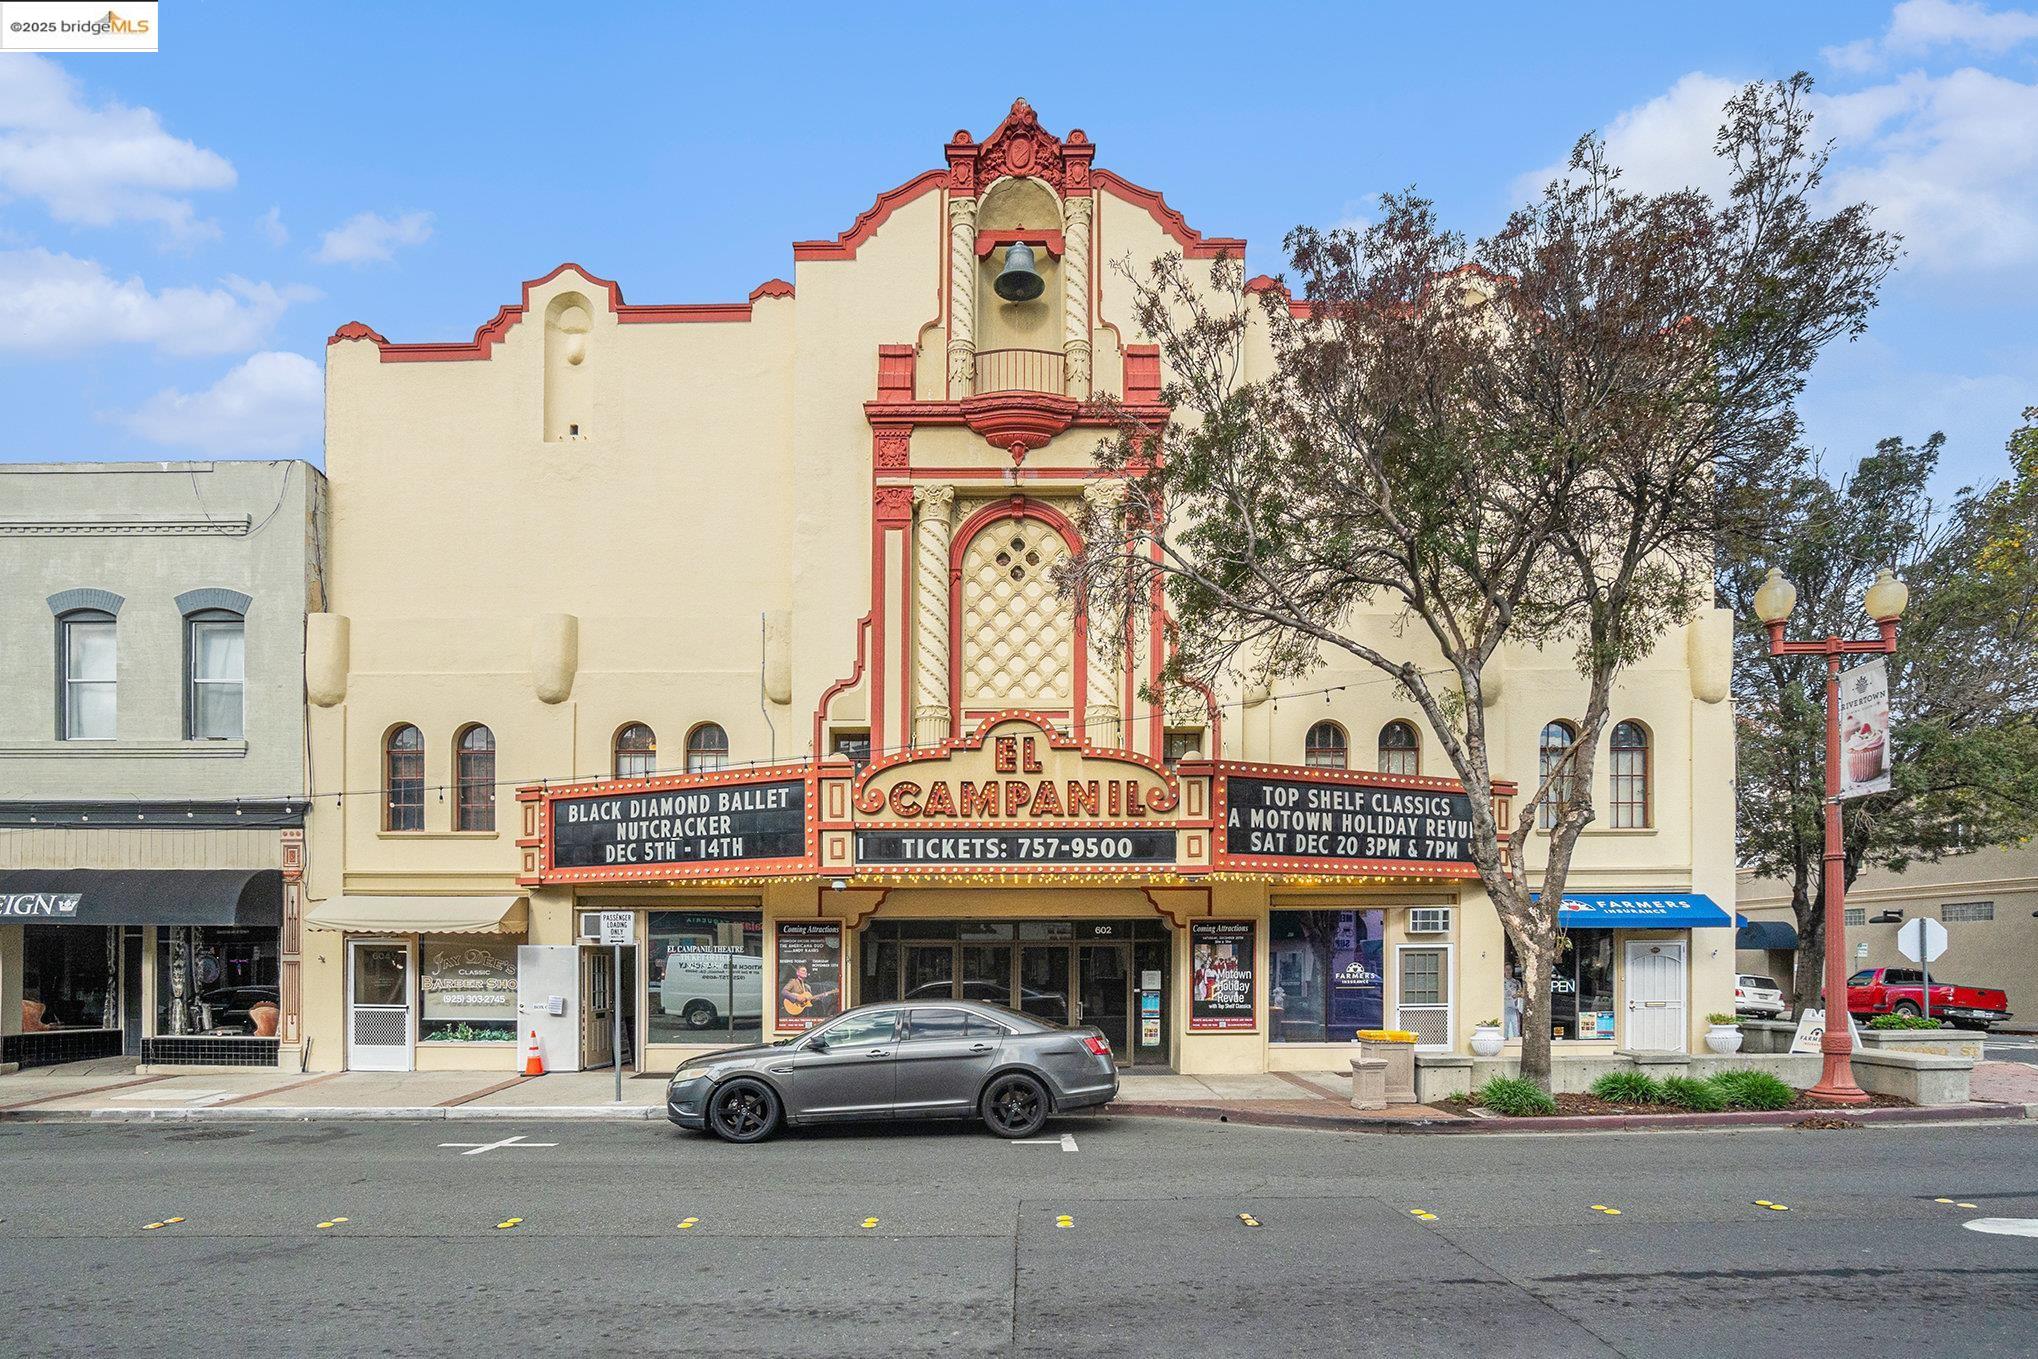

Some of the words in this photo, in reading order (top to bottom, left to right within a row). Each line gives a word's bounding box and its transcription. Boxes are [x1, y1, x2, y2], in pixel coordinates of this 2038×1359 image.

[1841, 690, 1886, 711] RIVERTOWN
[995, 736, 1043, 773] EL
[568, 801, 622, 822] BLACK
[630, 794, 711, 818] DIAMOND
[718, 788, 790, 812] BALLET
[888, 780, 1147, 818] CAMPANIL
[1263, 785, 1299, 807] TOP
[1308, 789, 1364, 812] SHELF
[1372, 793, 1450, 816] CLASSICS
[617, 815, 732, 841] NUTCRACKER
[1228, 808, 1240, 828] A
[1251, 809, 1333, 832] MOTOWN
[1342, 814, 1418, 836] HOLIDAY
[606, 843, 637, 863] DEC
[644, 841, 676, 861] 5TH
[700, 837, 743, 859] 14TH
[902, 838, 1008, 859] TICKETS:
[1017, 838, 1133, 859] 757-9500
[1251, 832, 1285, 853] SAT
[1296, 834, 1329, 855] DEC
[1337, 836, 1358, 856] 20
[1366, 837, 1400, 857] 3PM
[1407, 839, 1418, 857] &
[1425, 840, 1458, 859] 7PM
[1596, 900, 1691, 909] FARMERS
[783, 925, 807, 935] Coming
[807, 925, 840, 933] Attractions
[1095, 926, 1112, 934] 602
[1192, 924, 1216, 934] Coming
[1216, 924, 1248, 933] Attractions
[667, 945, 676, 953] EL
[677, 945, 712, 953] CAMPANIL
[712, 945, 744, 953] THEATRE
[432, 951, 461, 976] JAY
[421, 975, 484, 991] BARBER
[486, 977, 518, 990] SHO
[1218, 969, 1252, 980] Motown
[1217, 980, 1250, 994] Holiday
[1551, 980, 1575, 992] PEN
[443, 994, 465, 1003] (925)
[1217, 992, 1244, 1003] Revue
